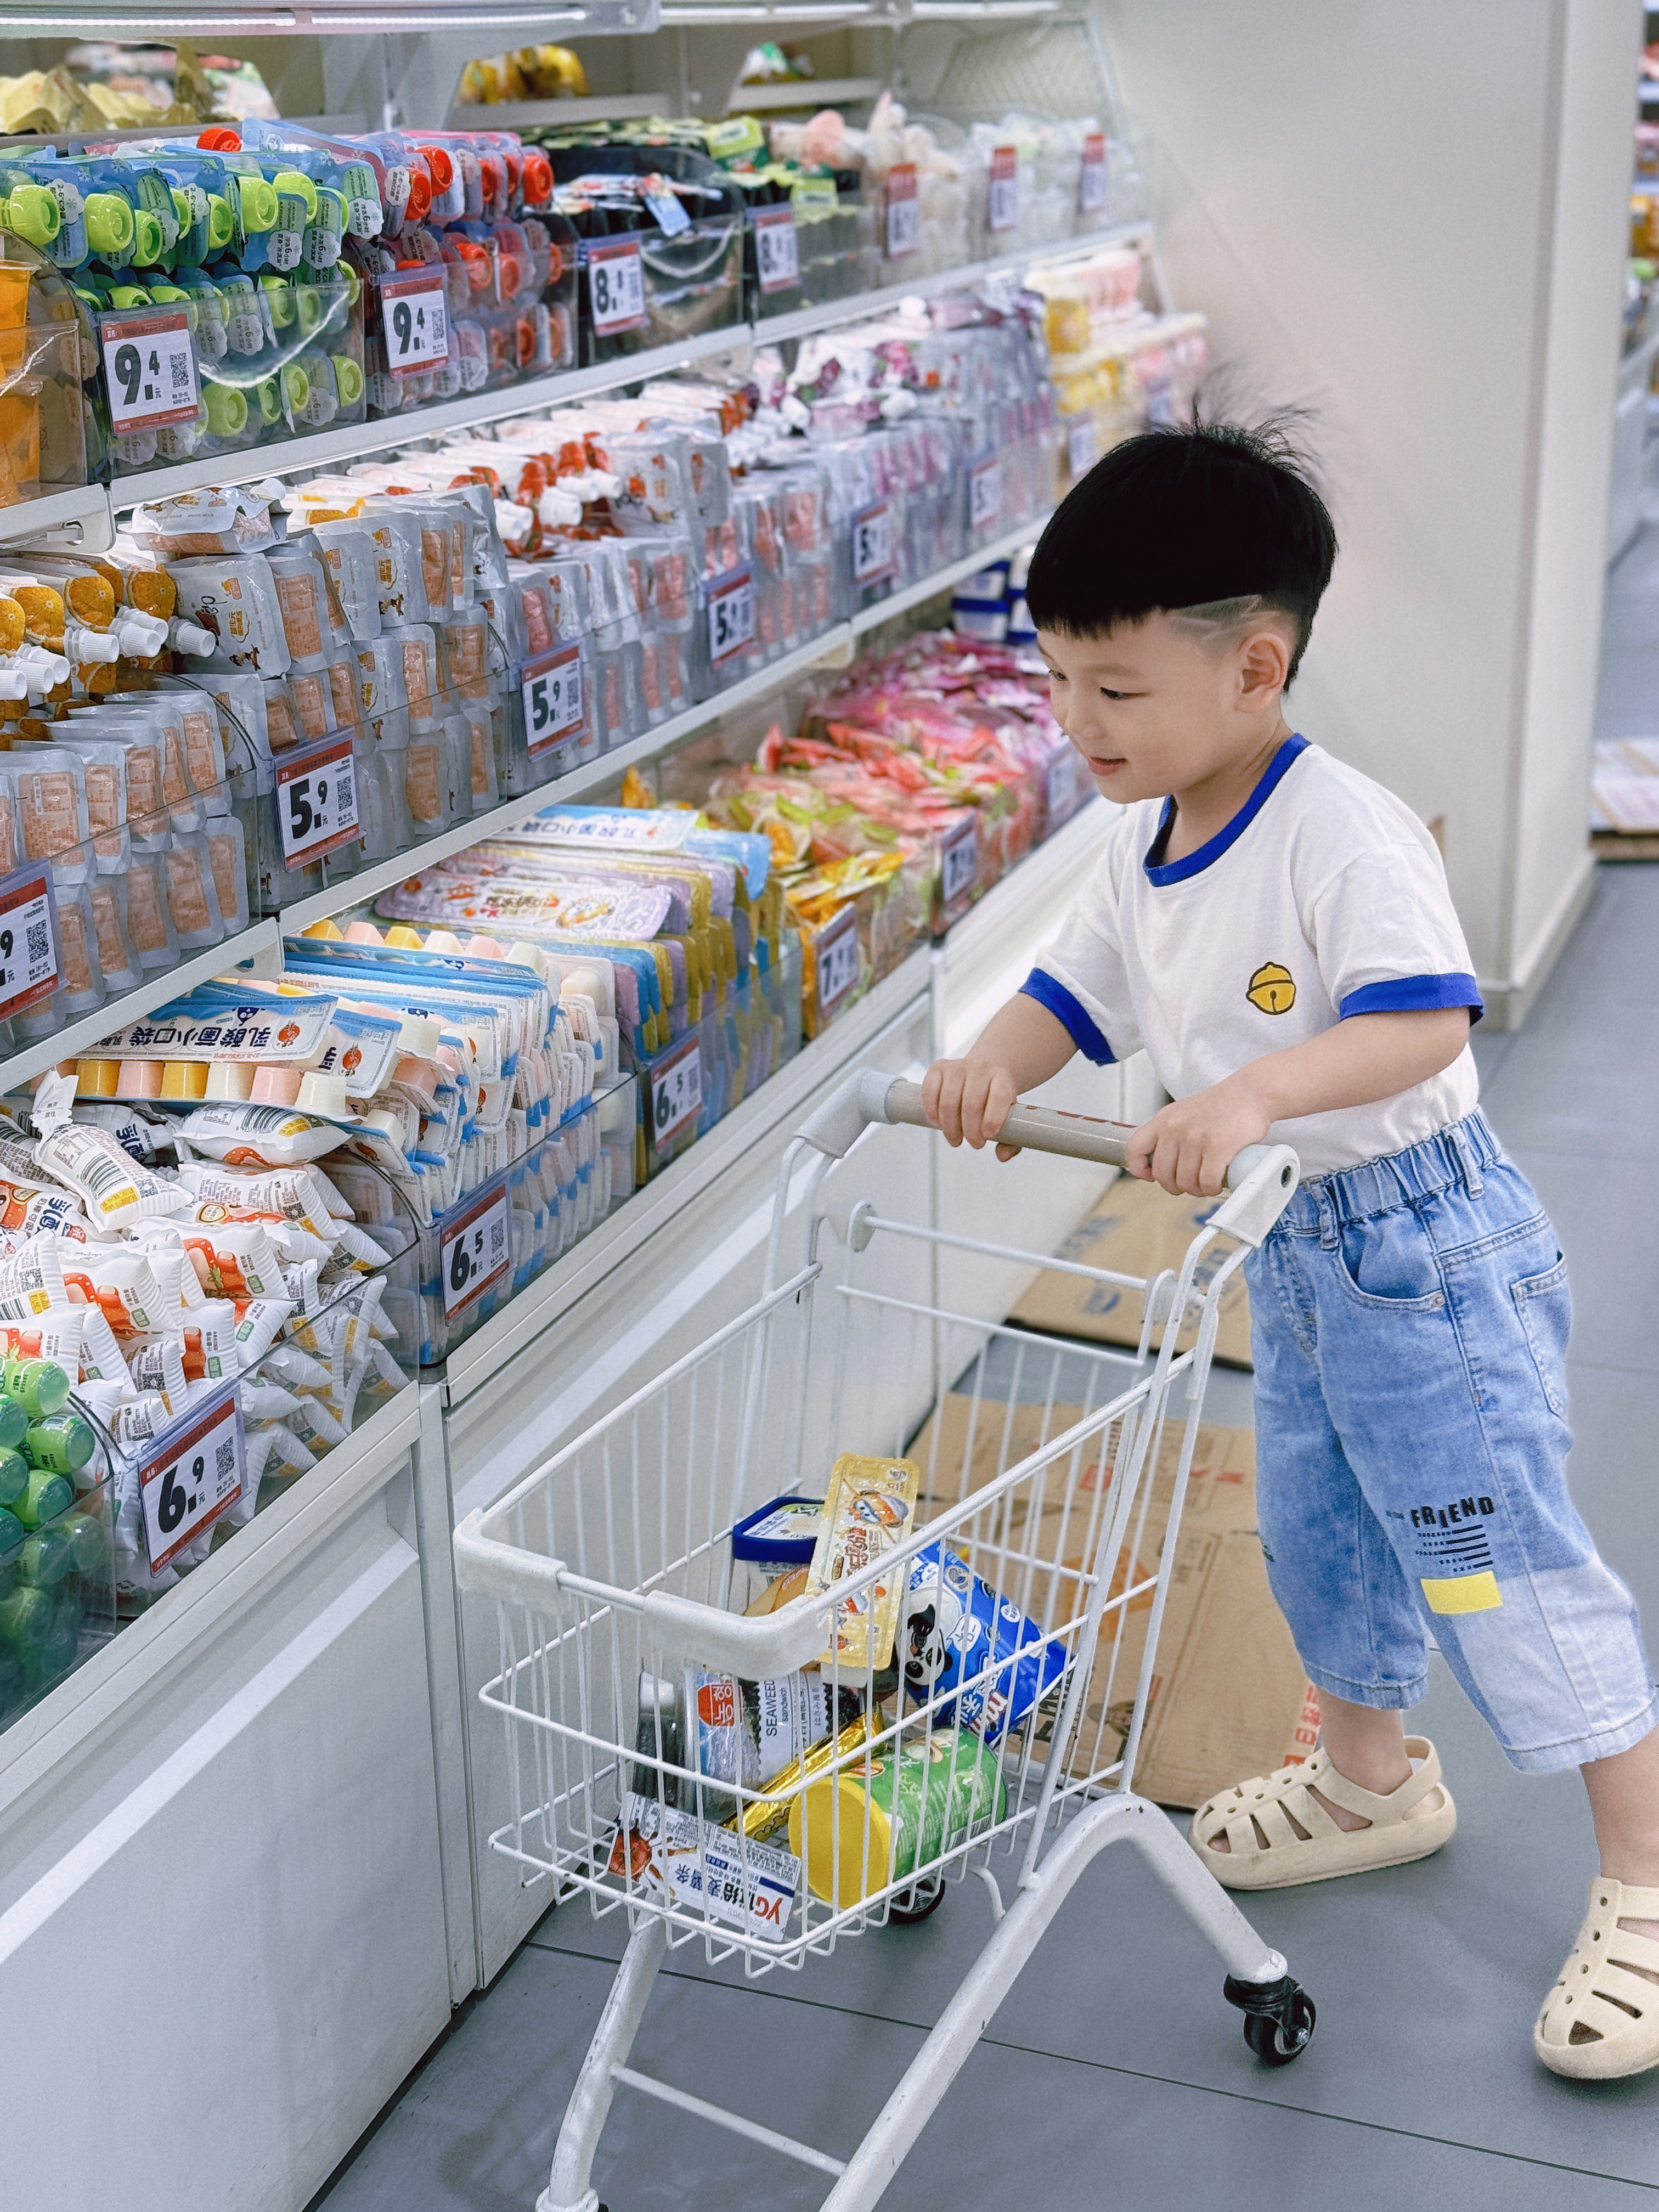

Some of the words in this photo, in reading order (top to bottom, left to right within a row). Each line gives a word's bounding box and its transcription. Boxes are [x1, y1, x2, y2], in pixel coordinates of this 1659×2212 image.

[129, 1026, 272, 1047] 乳酸菌小口袋
[157, 1464, 204, 1534] 6.9
[1409, 1496, 1496, 1529] FRIEND
[764, 1679, 777, 1737] SEAWEED
[779, 1686, 788, 1723] sandwich
